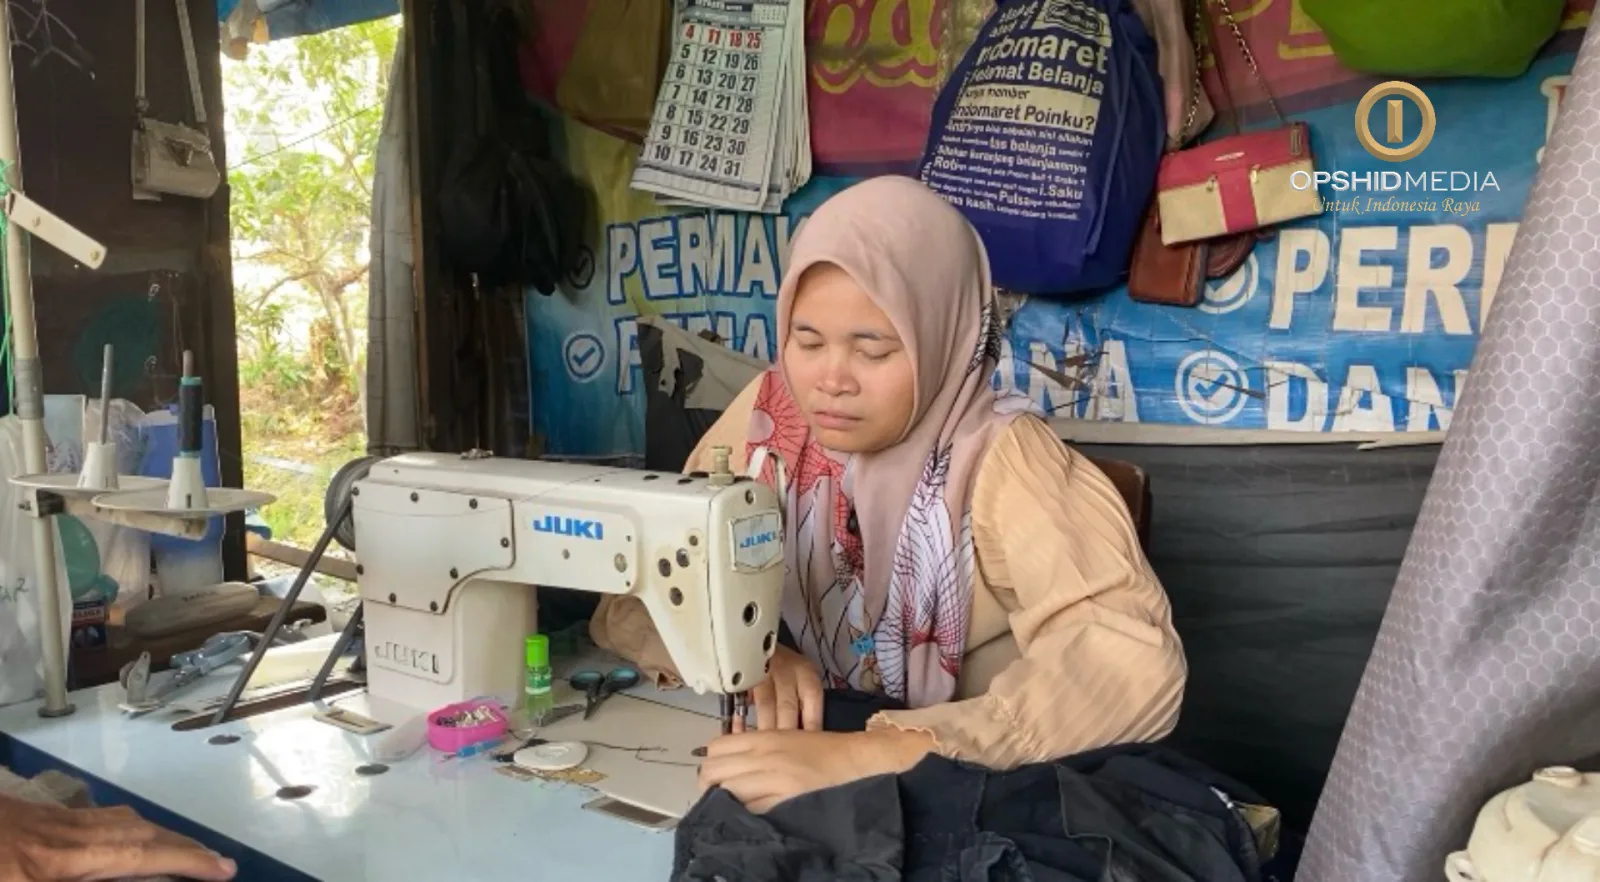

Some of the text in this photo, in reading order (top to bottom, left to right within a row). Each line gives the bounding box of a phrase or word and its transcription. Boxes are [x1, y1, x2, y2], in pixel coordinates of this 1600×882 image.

[685, 25, 761, 49] 4 11 18 25
[680, 44, 759, 71] 5 12 19 26
[976, 34, 1108, 74] ndomaret
[675, 64, 756, 93] 6 13 20 27
[1028, 61, 1105, 96] Belanja
[672, 85, 752, 113] 7 14 21 28
[666, 104, 749, 135] 8 15 22 29
[1024, 105, 1095, 130] Poinku?
[661, 125, 746, 156] 9 16 23 30
[990, 135, 1008, 149] tas
[1010, 139, 1056, 158] belanja
[655, 144, 741, 177] 10 17 24 31
[533, 515, 604, 541] JUKI
[739, 531, 778, 548] JUKI
[373, 640, 440, 674] JUKI
